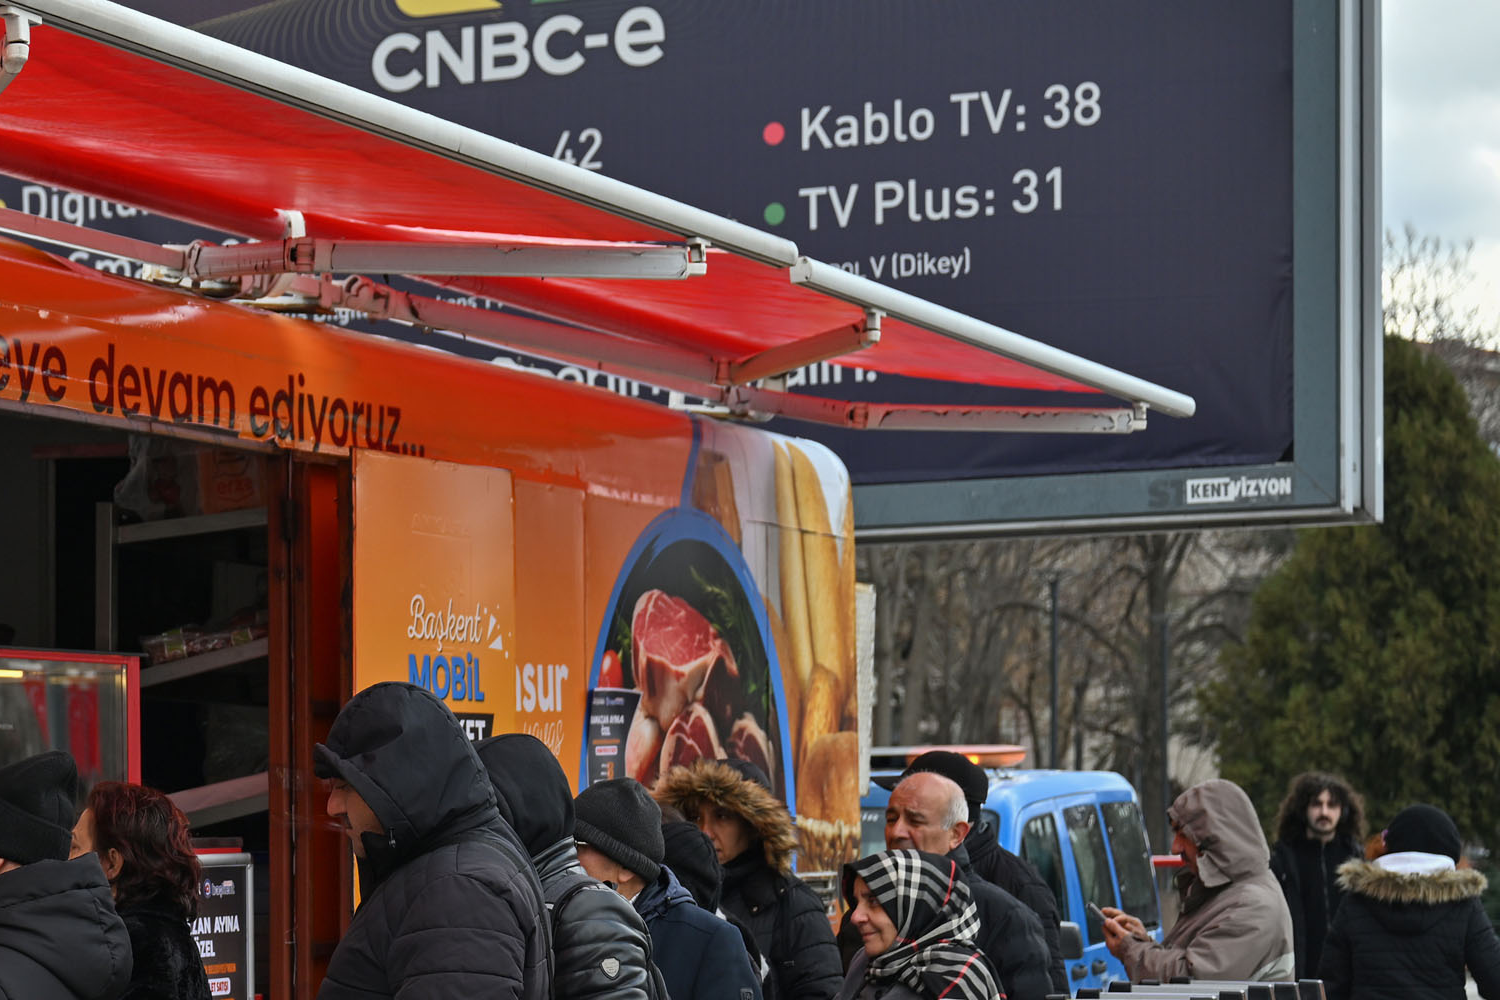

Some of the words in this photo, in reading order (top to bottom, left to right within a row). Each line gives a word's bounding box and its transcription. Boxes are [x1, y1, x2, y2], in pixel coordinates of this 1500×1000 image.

[372, 6, 665, 93] CNBC-e
[801, 98, 935, 151] Kablo
[950, 89, 1026, 137] TV:
[1044, 81, 1102, 129] 38
[799, 184, 859, 231] TV
[874, 179, 995, 225] Plus:
[1012, 166, 1063, 213] 31
[869, 254, 887, 279] V
[891, 246, 971, 280] (Dikey)
[88, 343, 235, 428] devam
[407, 594, 482, 652] Başkent
[213, 914, 240, 934] AYINA
